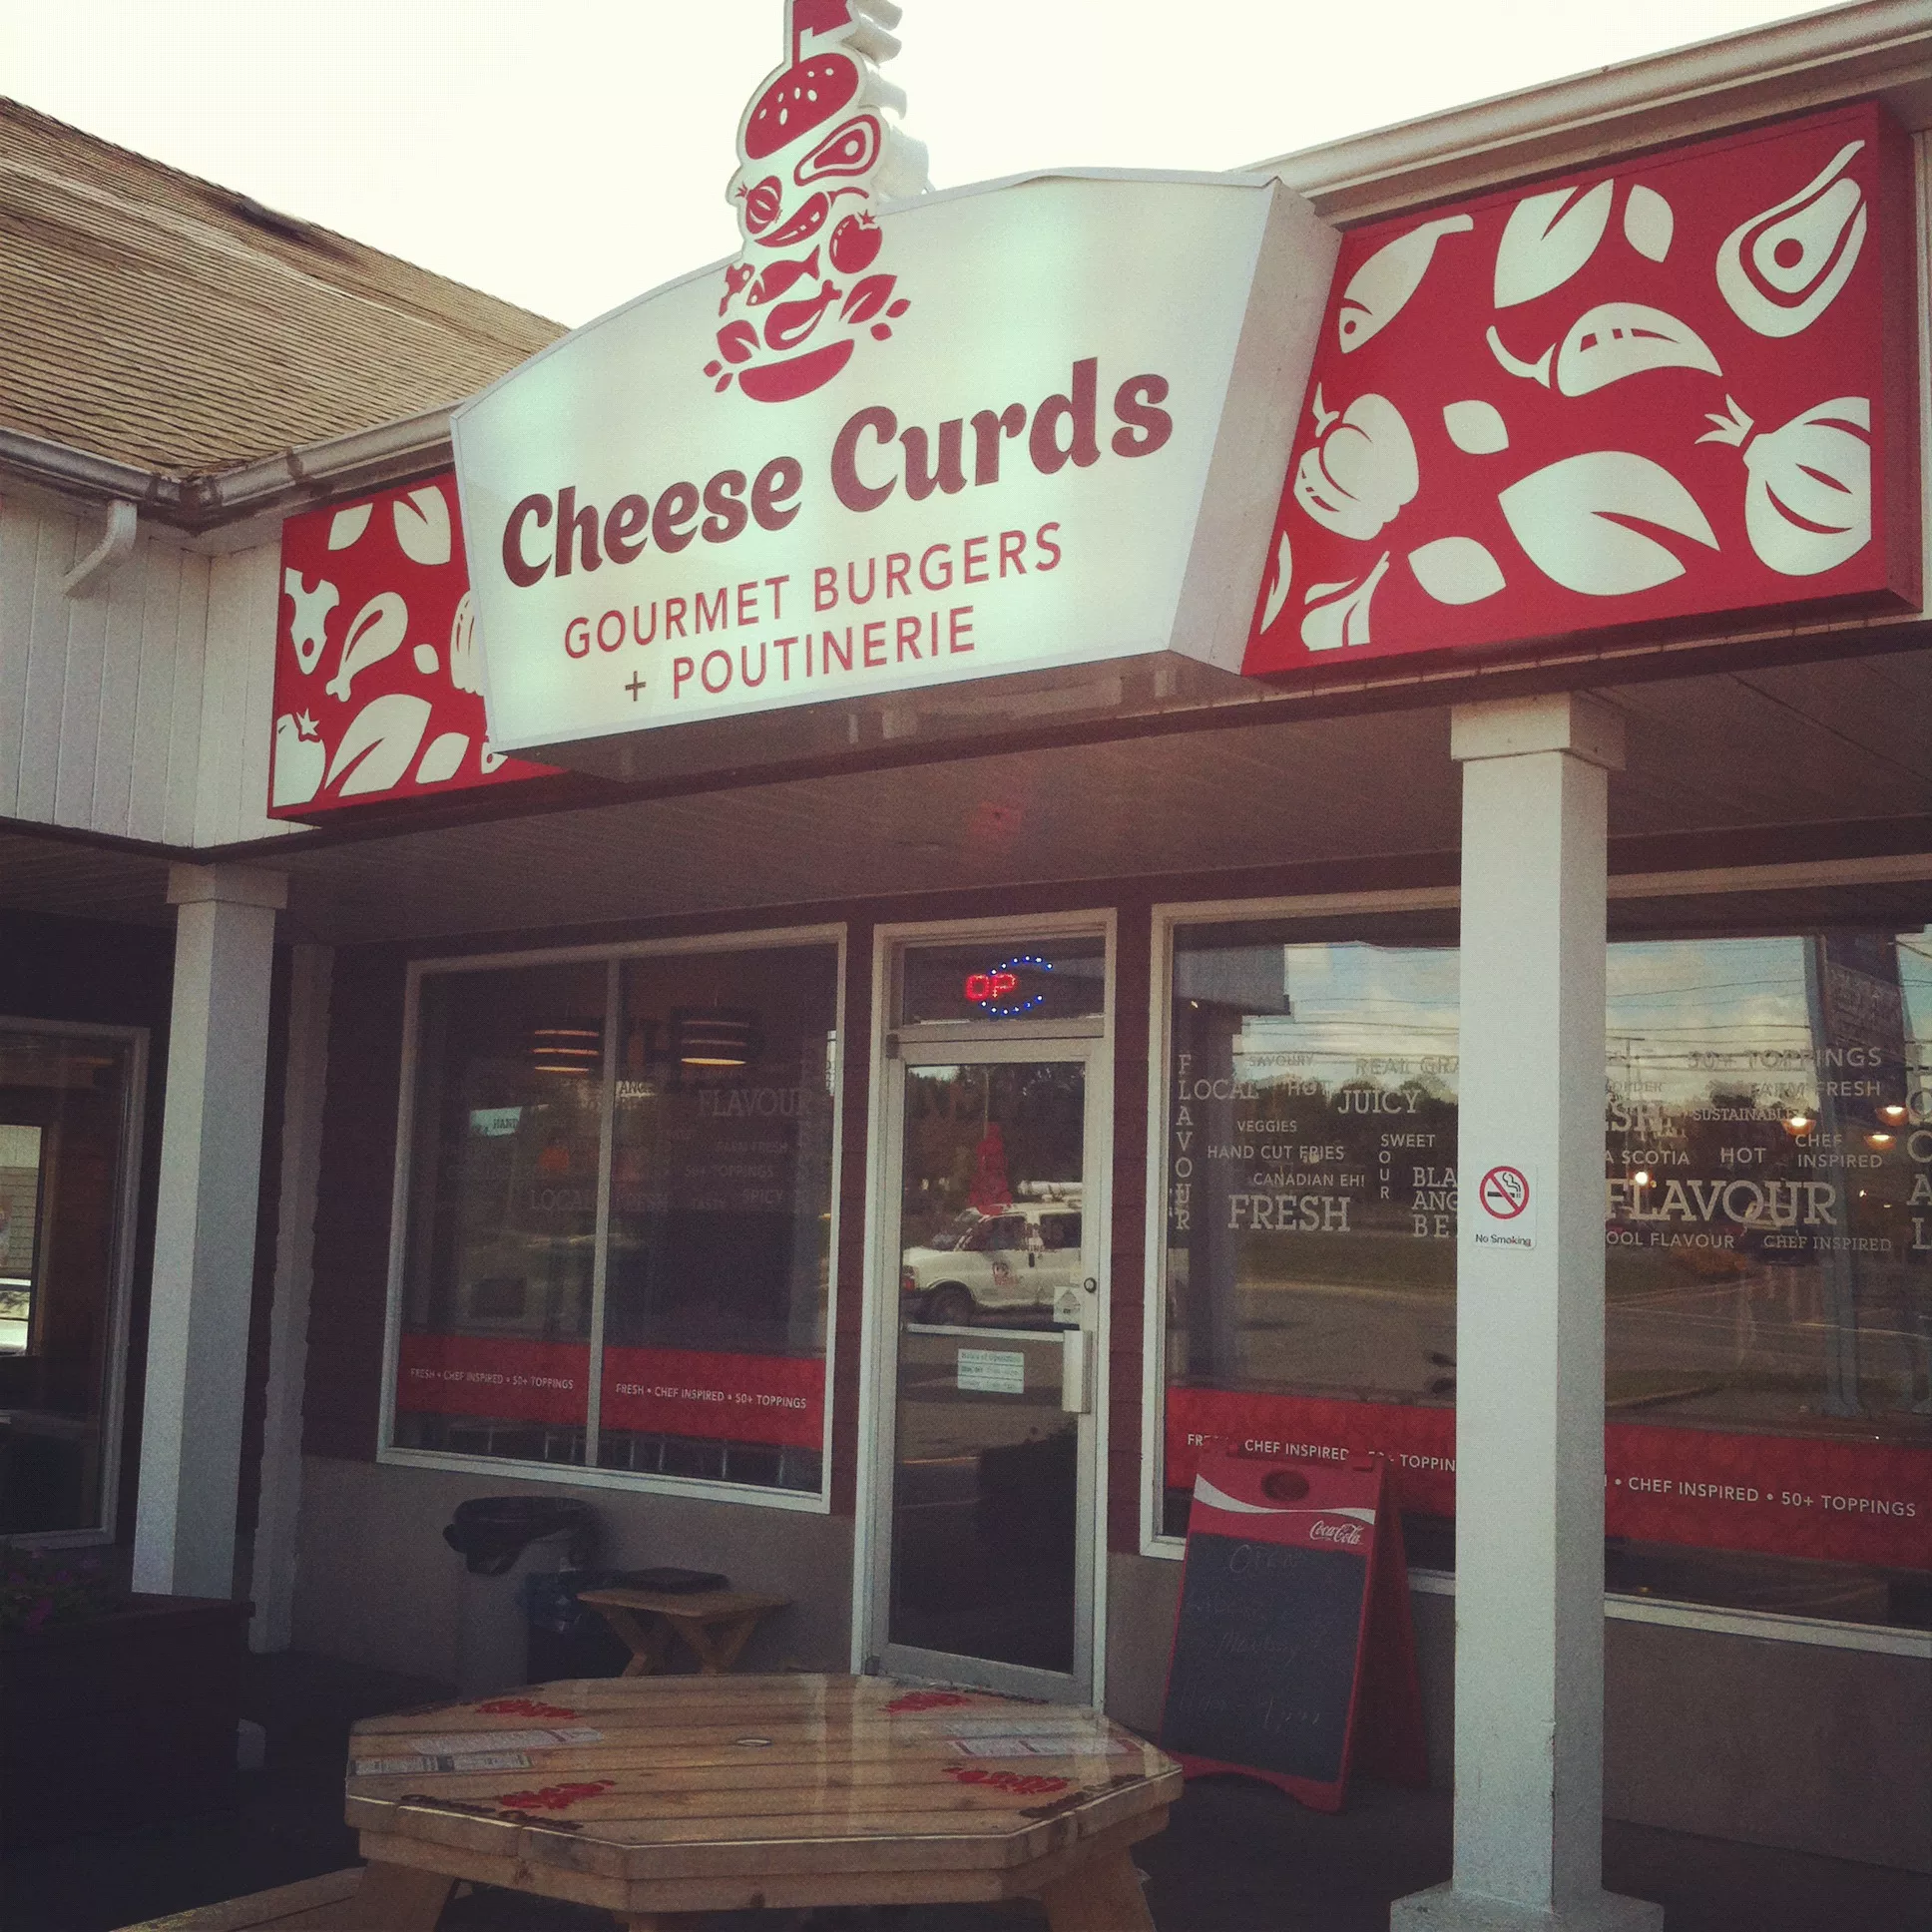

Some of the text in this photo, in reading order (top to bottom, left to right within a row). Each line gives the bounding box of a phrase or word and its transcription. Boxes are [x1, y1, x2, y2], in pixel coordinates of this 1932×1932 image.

[502, 356, 1173, 589] Cheese Curds
[565, 521, 1063, 660] GOURMET BURGERS
[625, 605, 975, 702] + POUTINERIE
[1248, 1055, 1314, 1067] SAVOURY
[1179, 1079, 1259, 1100] LOCAL
[1817, 1081, 1881, 1097] FRESH
[698, 1088, 812, 1117] FLAVOUR
[1337, 1089, 1422, 1115] JUICY
[1692, 1108, 1797, 1123] SUSTAINABLE
[1236, 1120, 1298, 1134] VEGGIES
[1175, 1054, 1194, 1229] FLAVOUR
[1380, 1134, 1436, 1148] SWEET
[1794, 1134, 1843, 1149] CHEF
[1208, 1146, 1345, 1161] HAND CUT FRIES
[1622, 1150, 1691, 1166] SCOTIA
[1720, 1147, 1767, 1165] HOT
[1797, 1154, 1883, 1169] INSPIRED
[1253, 1173, 1365, 1189] CANADIAN EH!
[1605, 1178, 1837, 1225] FLAVOUR
[1227, 1195, 1351, 1232] FRESH
[1412, 1213, 1457, 1238] BE
[1475, 1233, 1532, 1247] No Smoking
[1650, 1233, 1735, 1248] FLAVOUR
[1763, 1234, 1892, 1251] CHEF INSPIRED
[410, 1367, 435, 1379] FRESH
[443, 1370, 465, 1381] CHEF
[466, 1371, 503, 1385] INSPIRED
[531, 1376, 574, 1390] TOPPINGS
[616, 1383, 807, 1409] FRESH CHEF INSPIRED 50+ TOPPINGS
[1244, 1439, 1280, 1454] CHEF
[1285, 1443, 1349, 1462] INSPIRED
[1629, 1477, 1916, 1518] CHEF INSPIRED 50+ TOPPINGS
